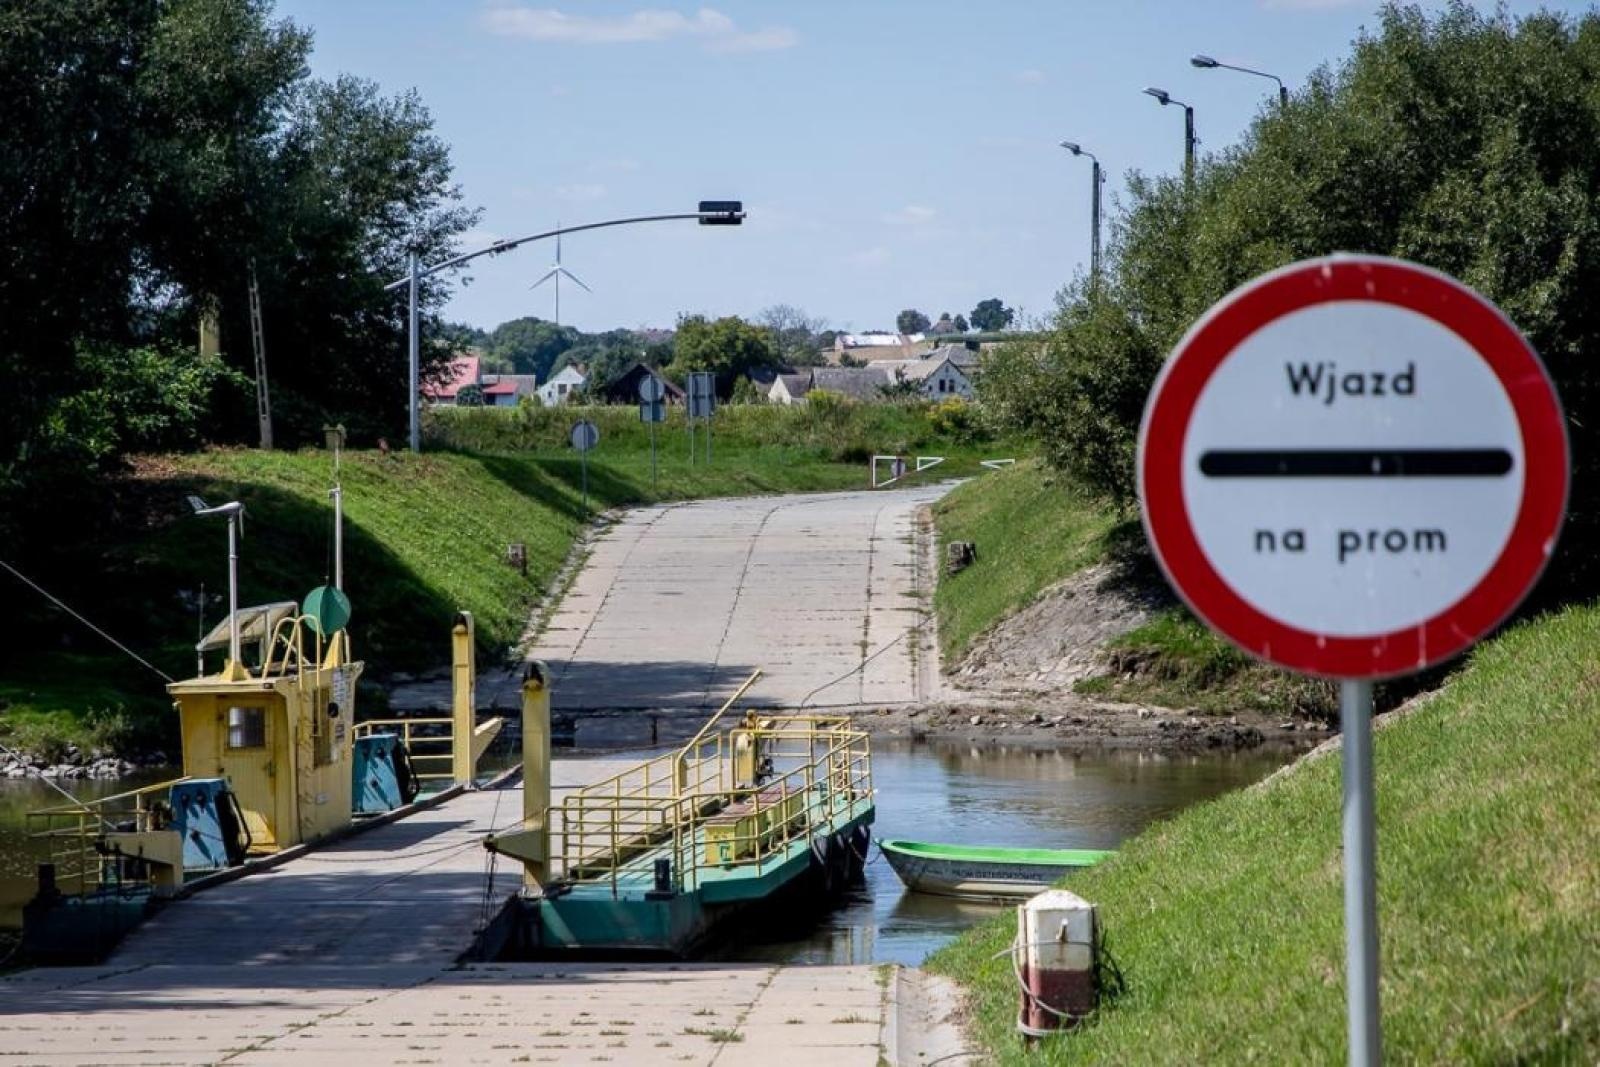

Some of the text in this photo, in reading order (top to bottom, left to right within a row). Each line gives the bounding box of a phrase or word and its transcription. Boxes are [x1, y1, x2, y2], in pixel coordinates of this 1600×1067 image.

[1286, 361, 1416, 406] Wjazd
[1255, 528, 1447, 565] na prom
